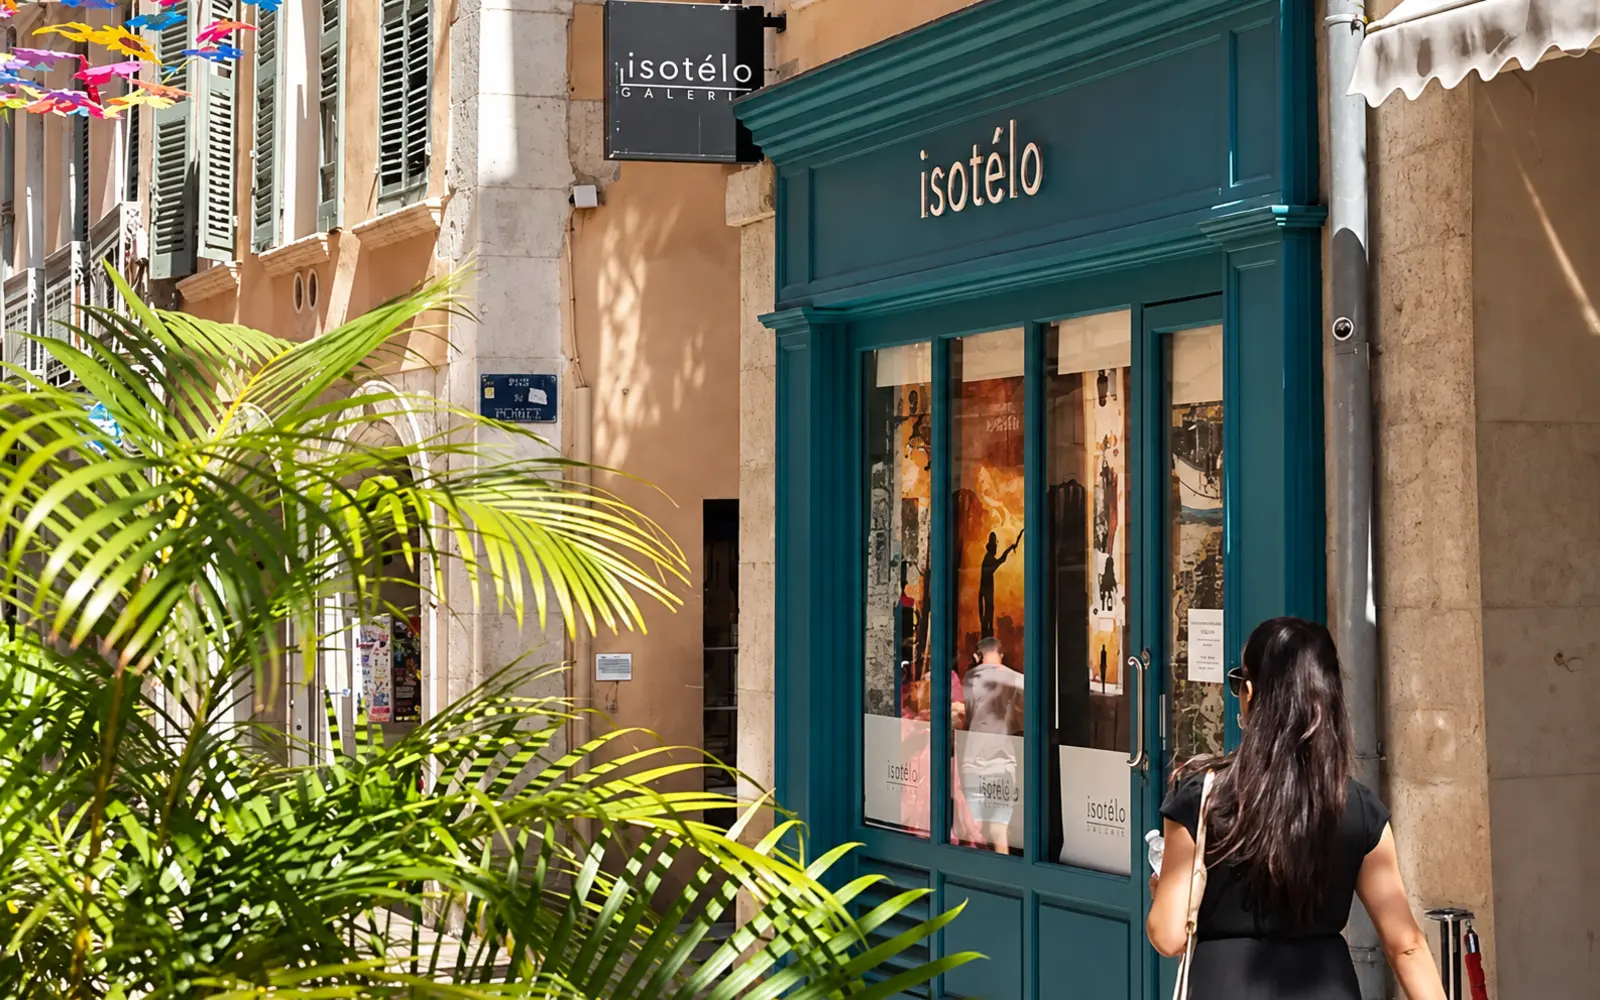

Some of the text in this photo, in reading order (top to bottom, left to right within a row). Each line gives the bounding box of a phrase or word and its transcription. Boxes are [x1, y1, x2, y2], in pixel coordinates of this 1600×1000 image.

[628, 51, 752, 83] isotélo
[621, 87, 749, 101] GALERI
[920, 119, 1043, 219] isotélo
[887, 759, 918, 783] isotélo
[1087, 795, 1126, 823] isotélo
